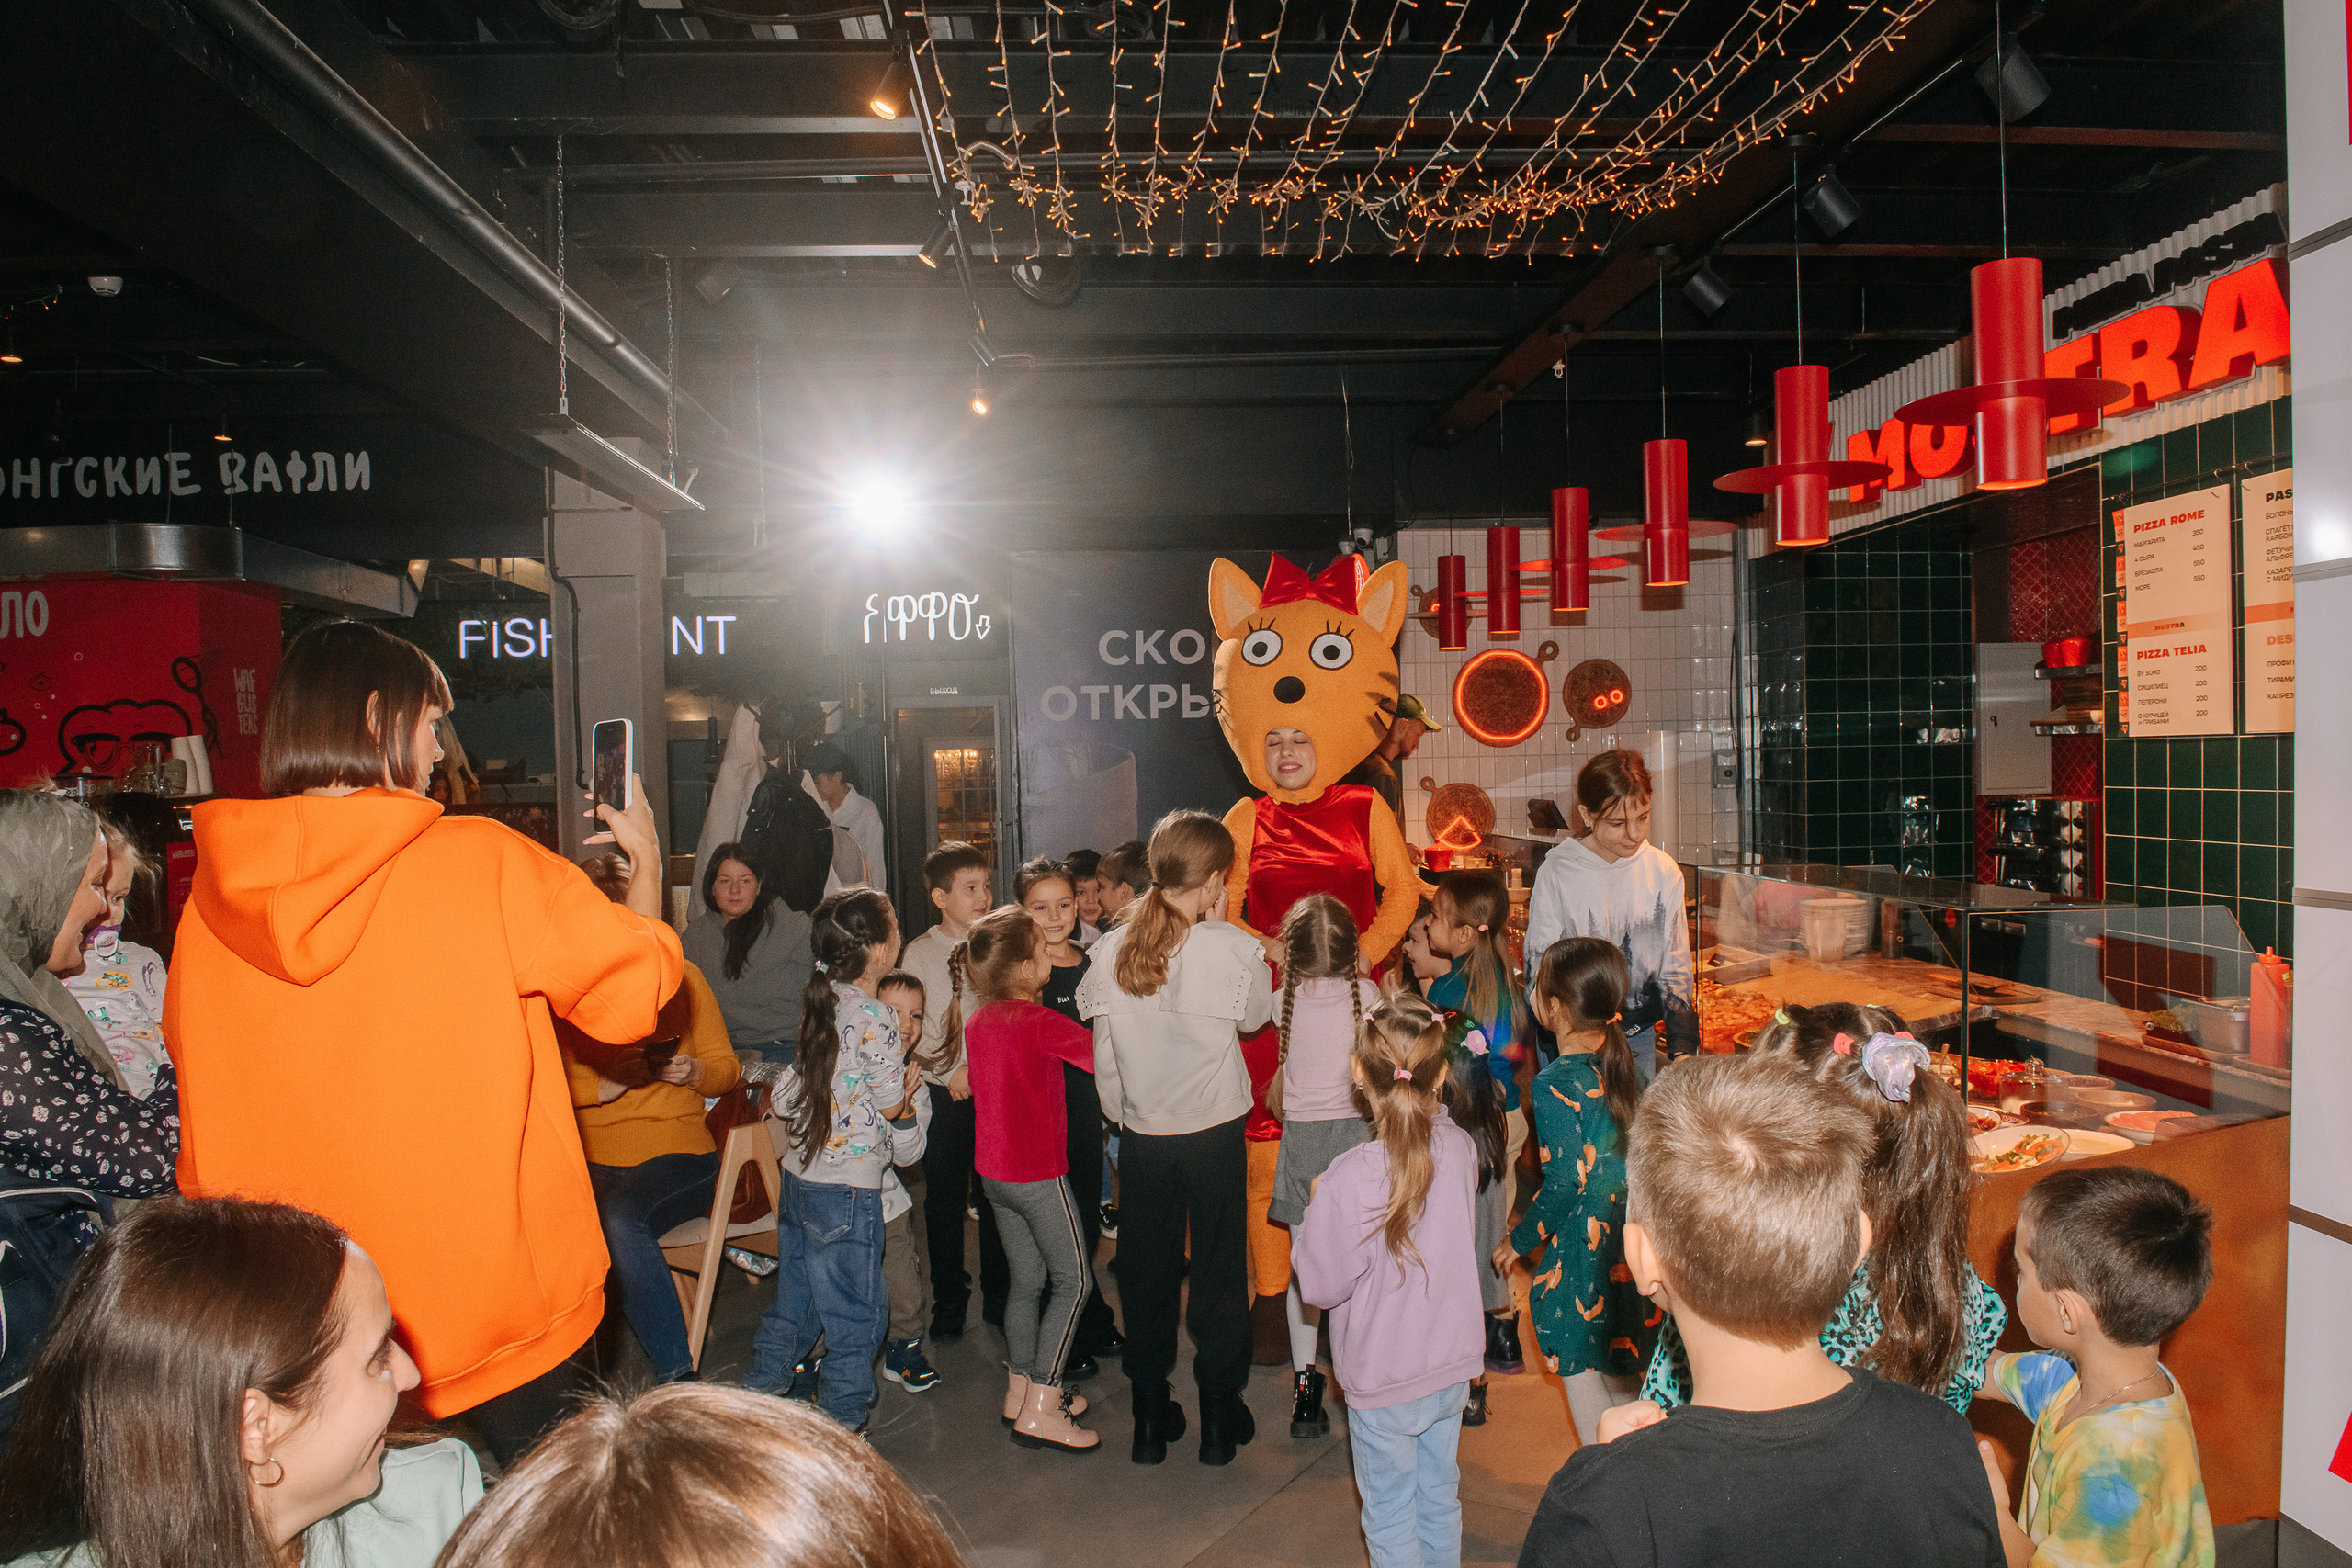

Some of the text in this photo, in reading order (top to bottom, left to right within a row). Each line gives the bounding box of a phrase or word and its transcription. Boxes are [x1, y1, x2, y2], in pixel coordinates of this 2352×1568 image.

[1848, 257, 2291, 503] MOTRA
[0, 450, 371, 499] НГСКИЕ ВАФЛИ
[2133, 509, 2205, 533] PIZZA ROME
[2133, 528, 2204, 548] МАРГАРИТА 350
[2139, 554, 2155, 562] СЫРА
[2154, 622, 2186, 631] MOSTRA
[1098, 628, 1216, 666] СКО
[2136, 644, 2207, 660] PIZZA TELIA
[929, 686, 958, 694] ВЫХОД
[2143, 710, 2169, 718] КУРИЦЕЙ
